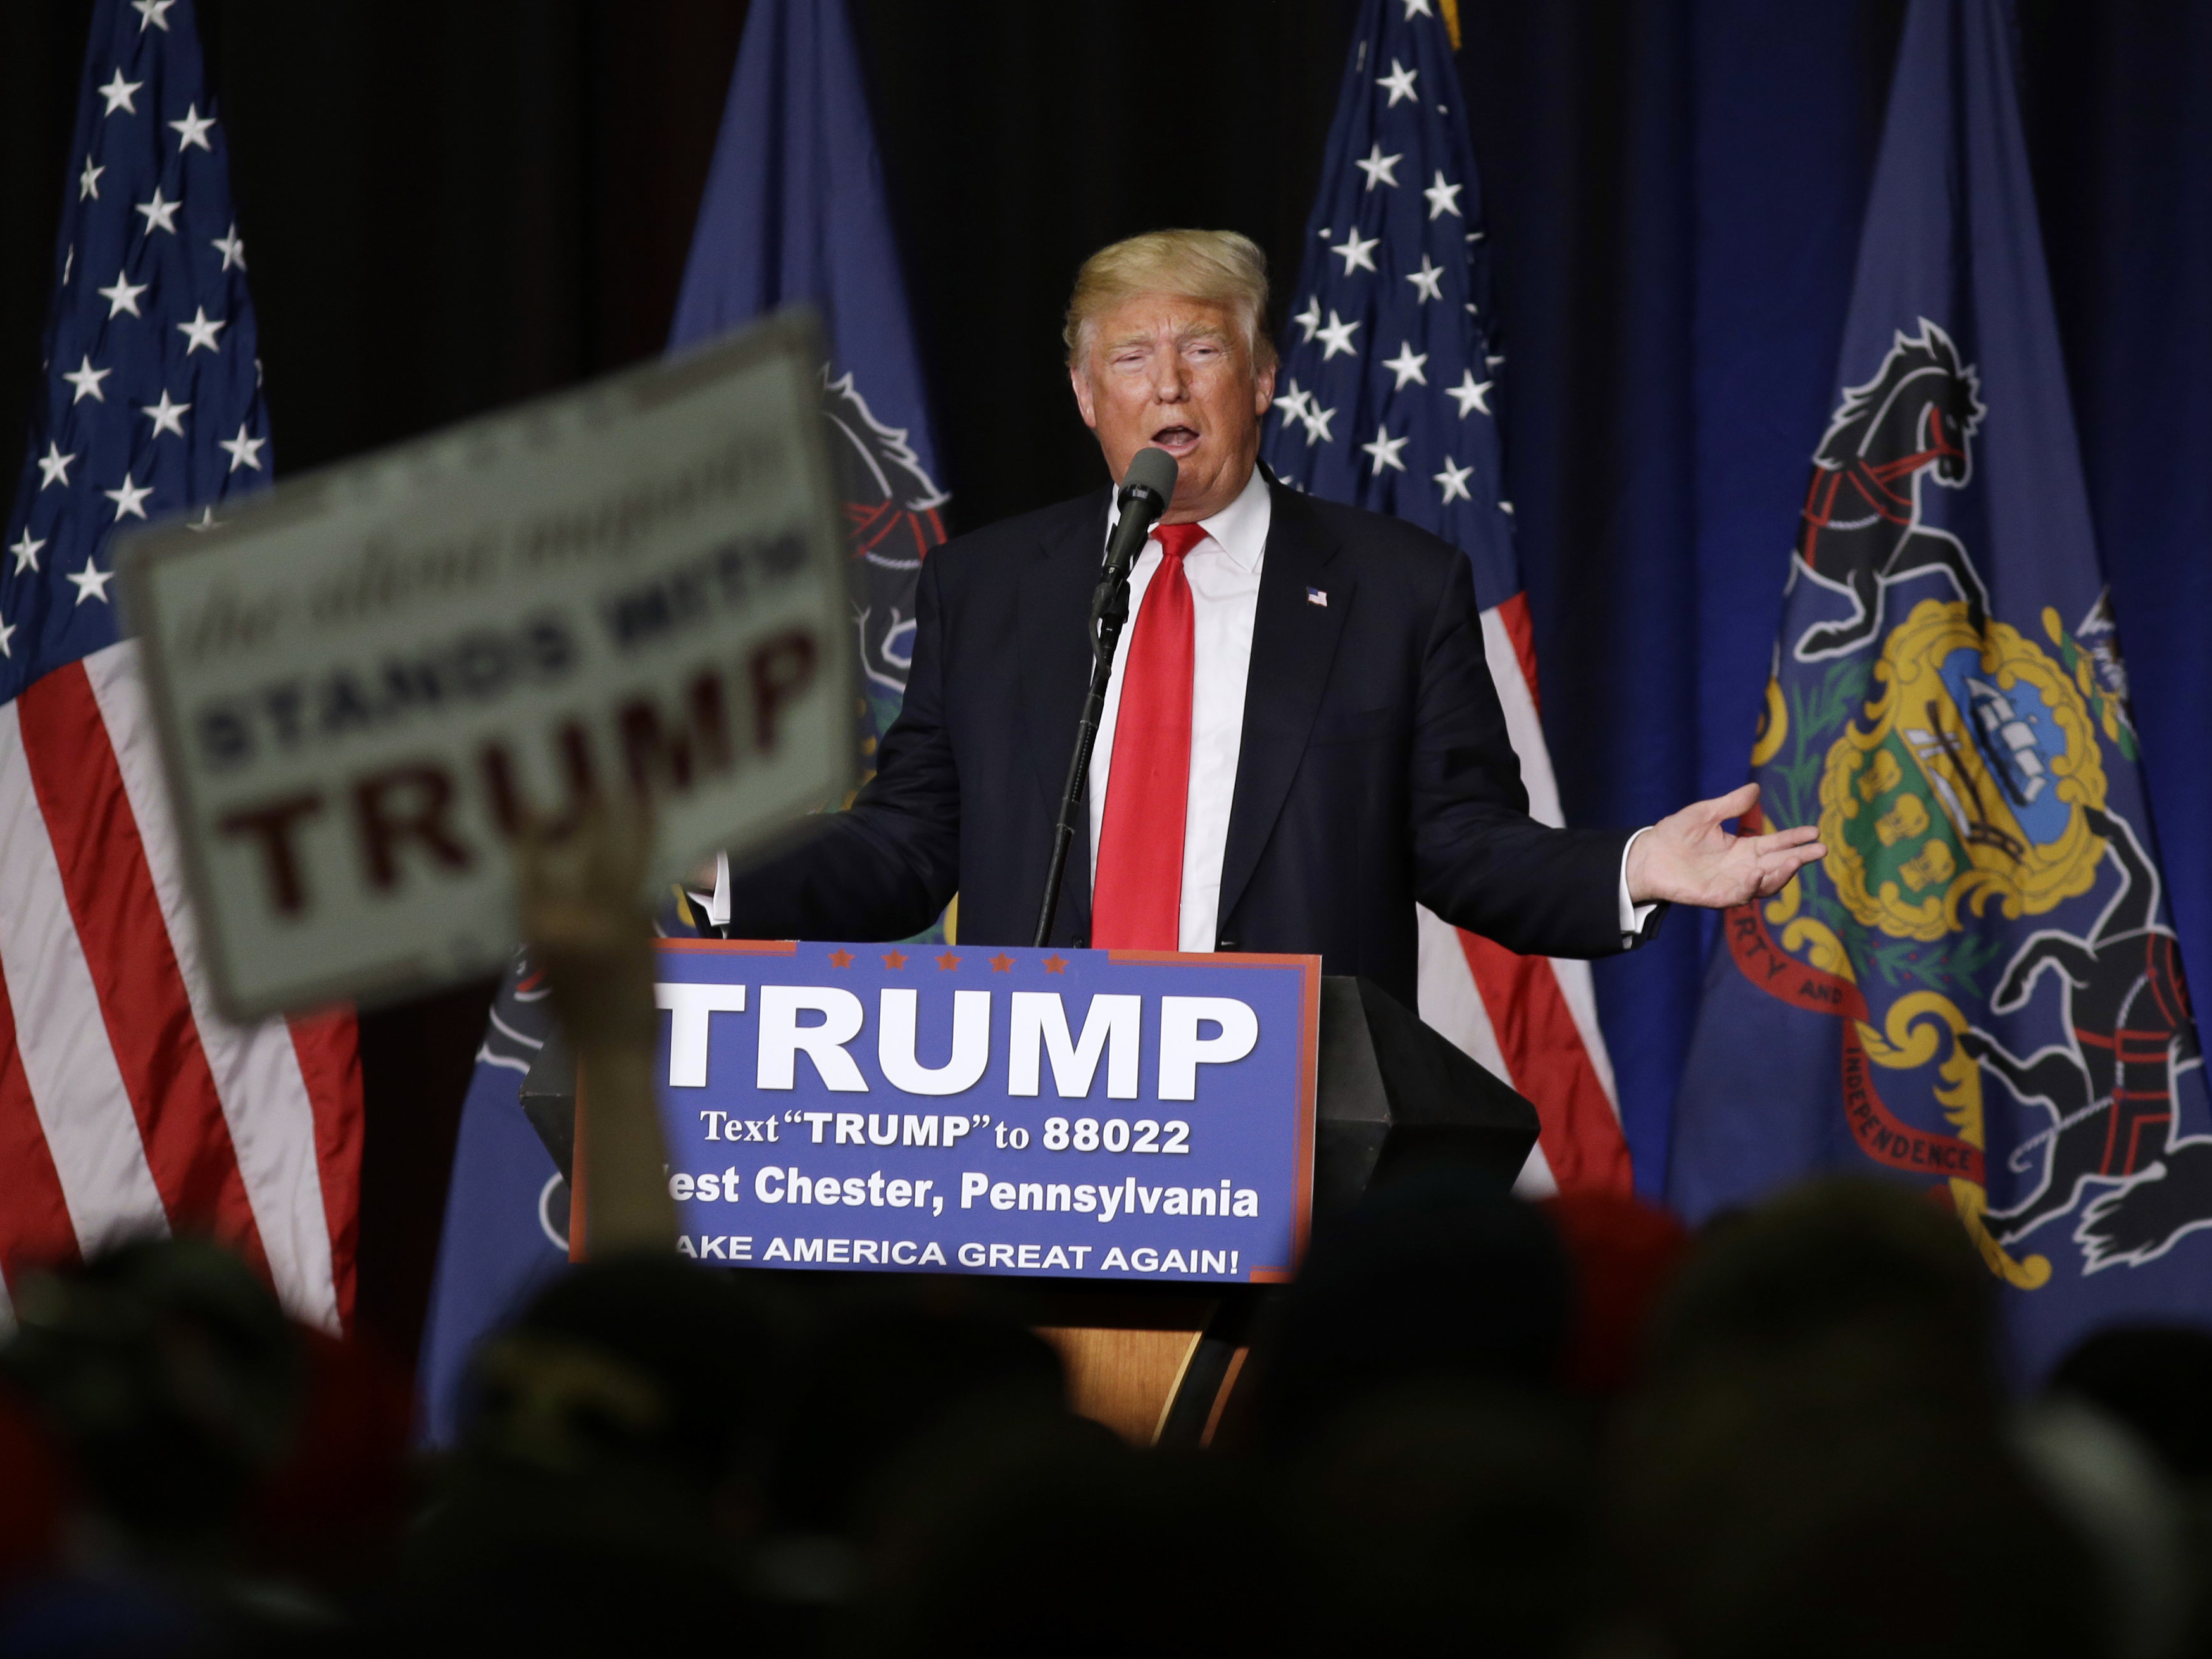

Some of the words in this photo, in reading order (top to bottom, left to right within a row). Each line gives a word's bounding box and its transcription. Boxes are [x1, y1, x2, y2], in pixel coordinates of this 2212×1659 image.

[196, 606, 582, 772] STANDS
[598, 525, 807, 651] WITH
[215, 625, 816, 920] TRUMP
[654, 982, 1259, 1101] TRUMP
[1799, 979, 1843, 1004] AND
[1846, 1048, 1972, 1170] INDEPENDENCE
[700, 1110, 780, 1143] Text
[784, 1110, 990, 1148] “TRUMP”
[994, 1120, 1030, 1149] to
[1042, 1117, 1190, 1153] 88022
[663, 1164, 740, 1203] est
[754, 1166, 944, 1217] Chester,
[959, 1171, 1259, 1223] Pennsylvania
[675, 1235, 753, 1260] AKE
[762, 1237, 947, 1267] AMERICA
[957, 1242, 1093, 1270] GREAT
[1100, 1246, 1240, 1275] AGAIN!
